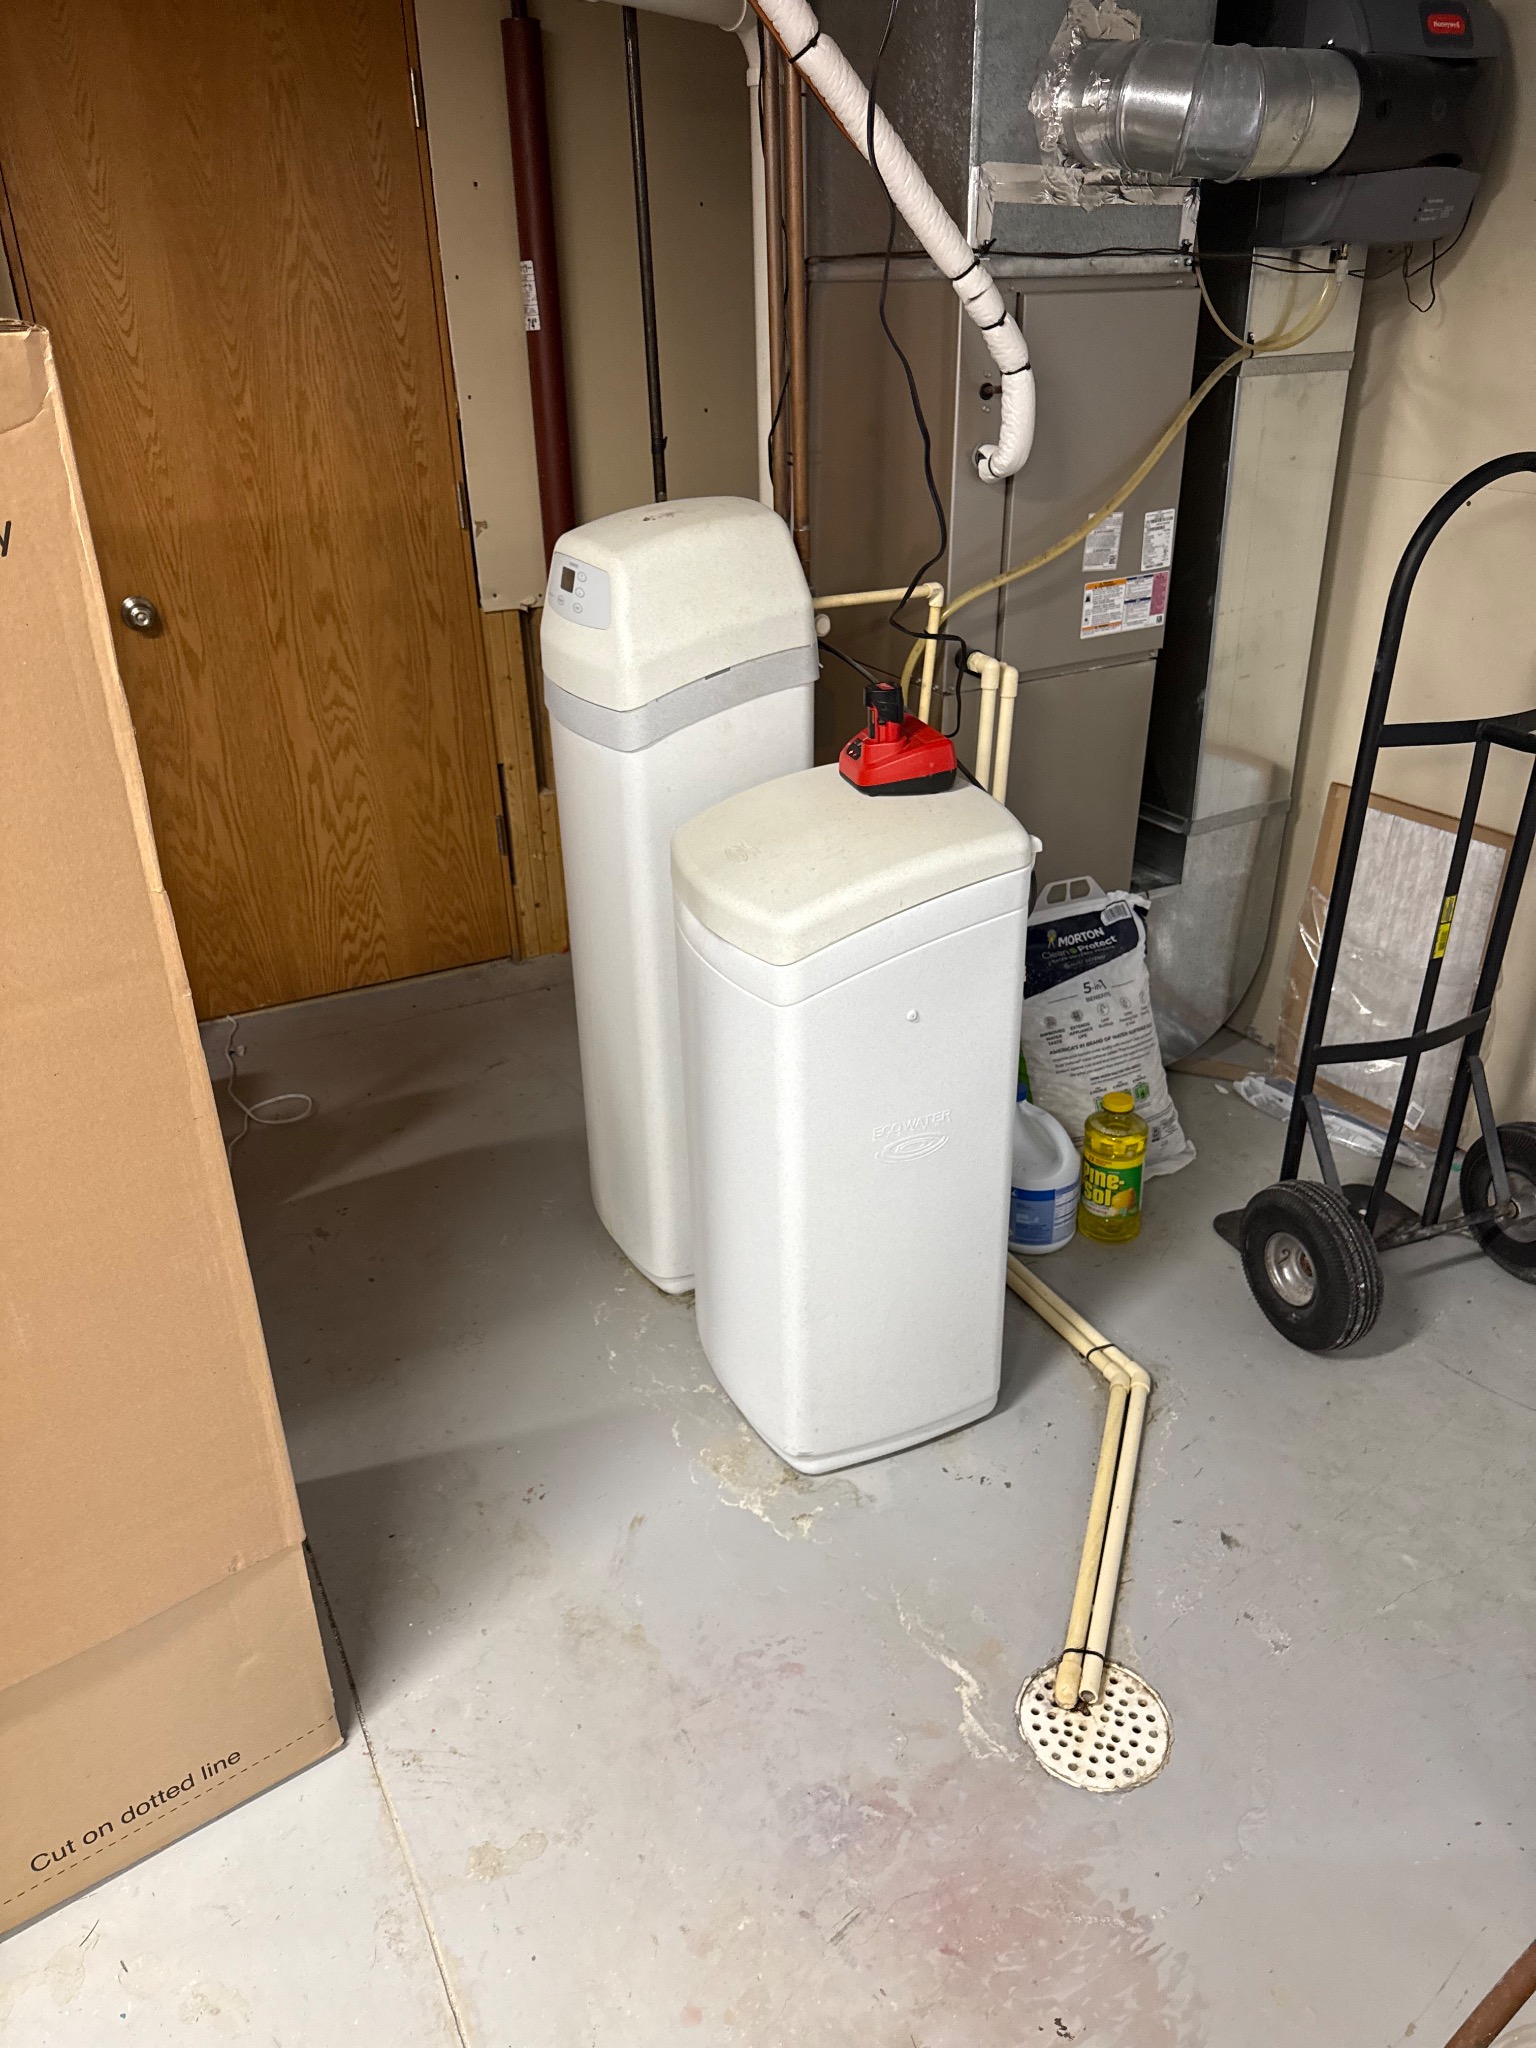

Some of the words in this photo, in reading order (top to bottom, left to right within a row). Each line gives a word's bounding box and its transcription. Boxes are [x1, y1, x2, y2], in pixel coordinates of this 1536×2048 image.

[1057, 927, 1105, 947] MORTON
[1077, 935, 1117, 952] Protect
[1083, 1161, 1125, 1190] Pine-
[30, 1839, 77, 1872] Cut
[82, 1820, 114, 1845] on
[120, 1773, 195, 1825] dotted
[200, 1750, 241, 1781] line
